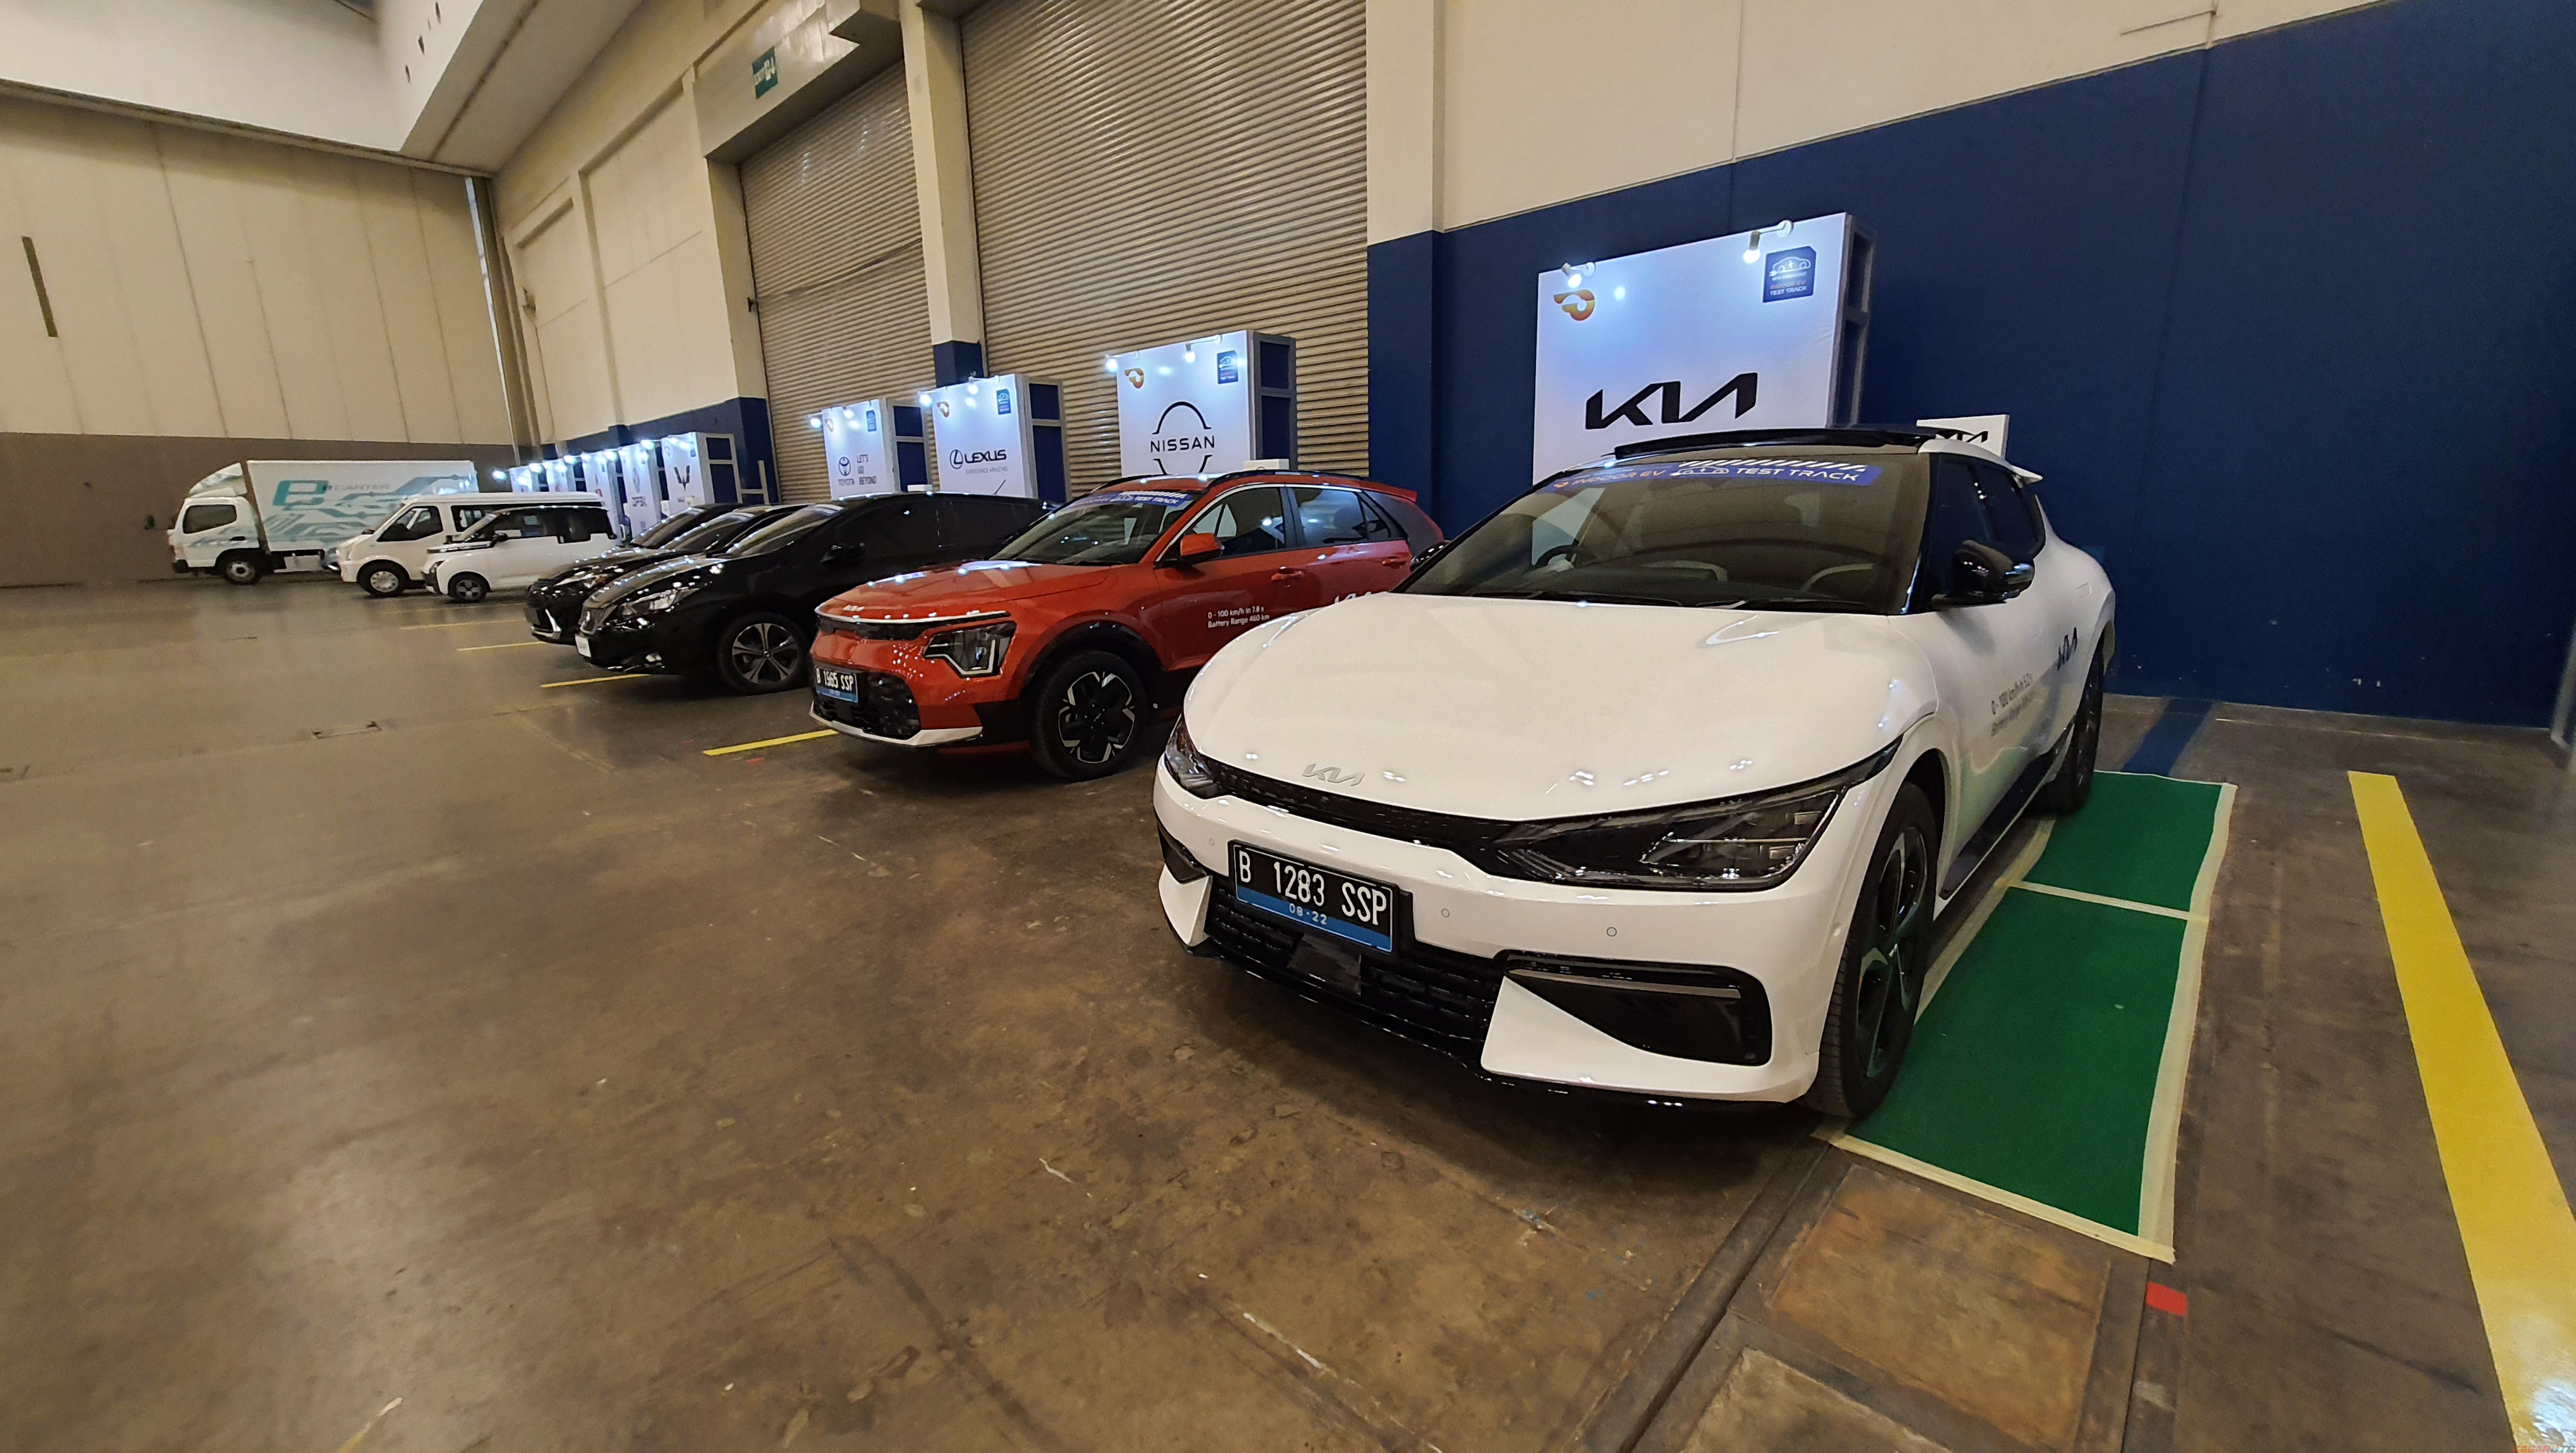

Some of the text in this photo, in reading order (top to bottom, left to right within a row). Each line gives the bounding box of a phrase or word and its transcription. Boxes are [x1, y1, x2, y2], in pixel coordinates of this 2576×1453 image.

[1586, 372, 1758, 430] KIA
[1150, 435, 1215, 453] NISSAN
[964, 449, 1007, 464] LEXUS
[838, 478, 855, 486] TOYOTA
[858, 475, 876, 485] BEYOND
[1789, 469, 1859, 481] TRACK
[1218, 609, 1229, 618] 100
[1230, 607, 1244, 616] km/h
[1208, 620, 1229, 629] Battery
[816, 668, 821, 683] B
[840, 674, 853, 691] SSP
[1302, 763, 1365, 787] KIA
[1239, 850, 1387, 926] B 1283 SSP
